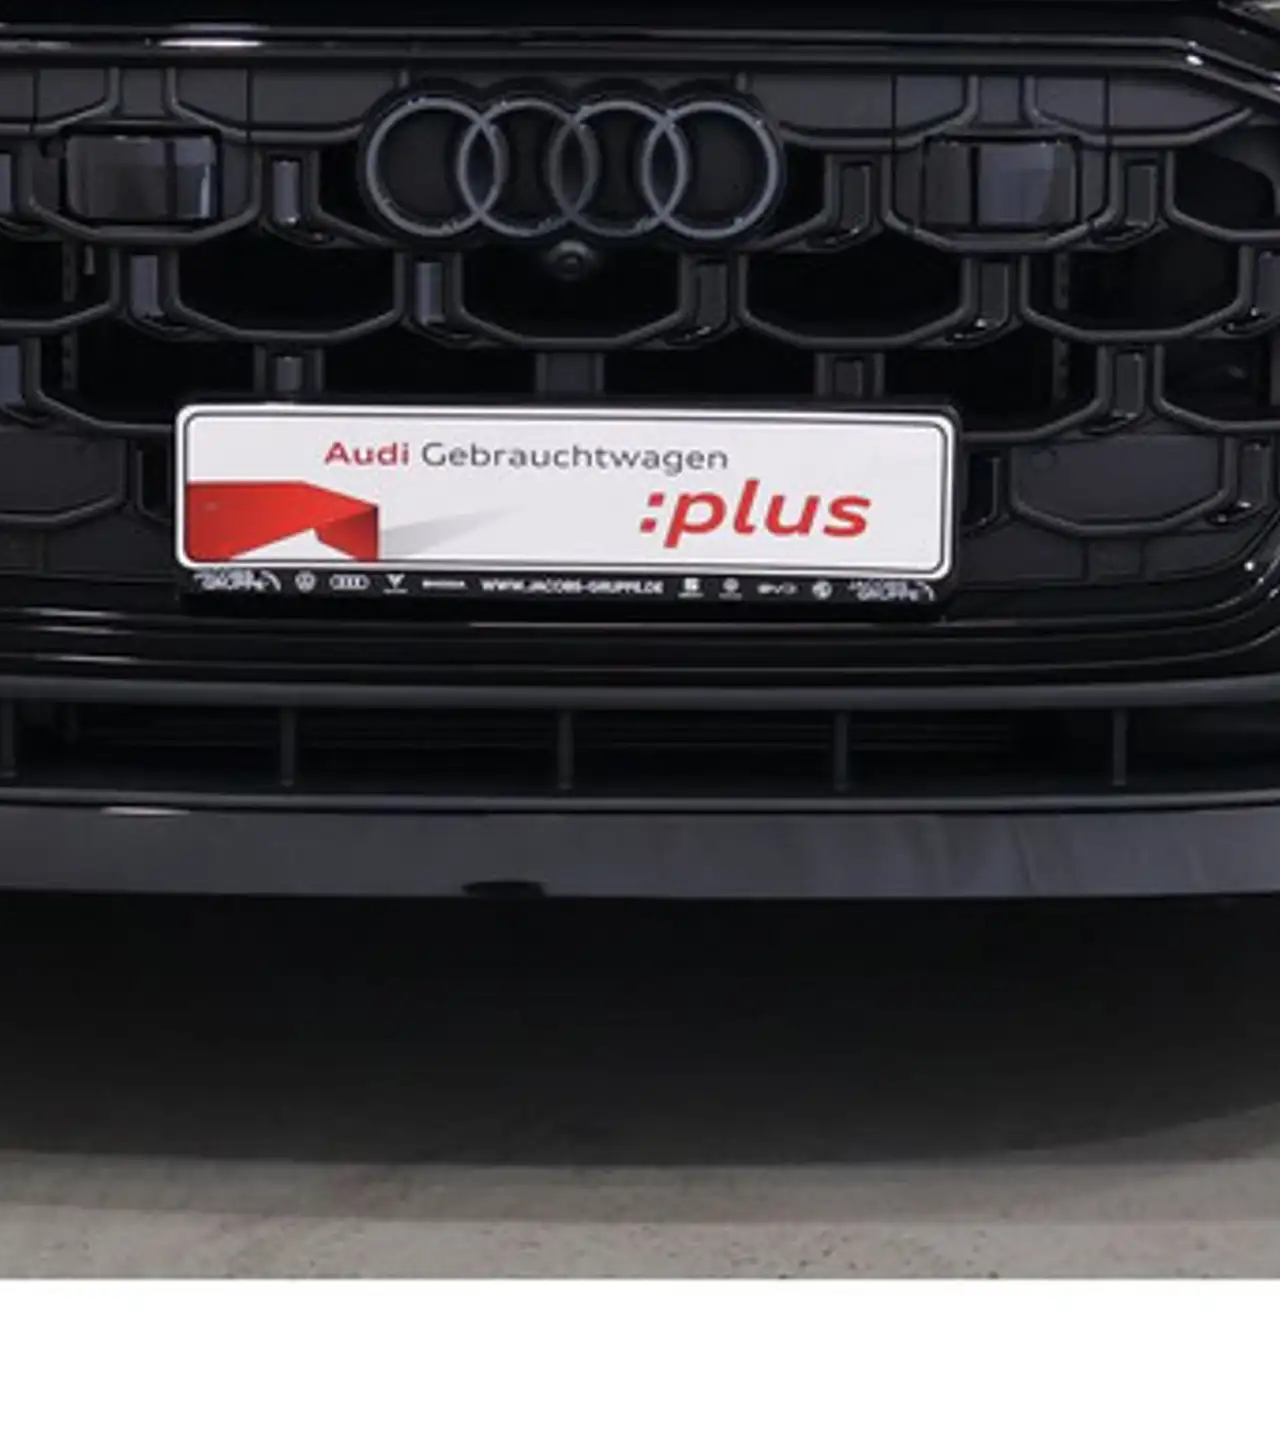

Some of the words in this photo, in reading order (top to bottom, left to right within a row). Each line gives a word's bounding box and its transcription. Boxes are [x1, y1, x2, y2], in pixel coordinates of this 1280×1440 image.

[323, 440, 409, 467] Audi
[421, 441, 728, 476] Gebrauchtwagen
[640, 478, 872, 549] :plus
